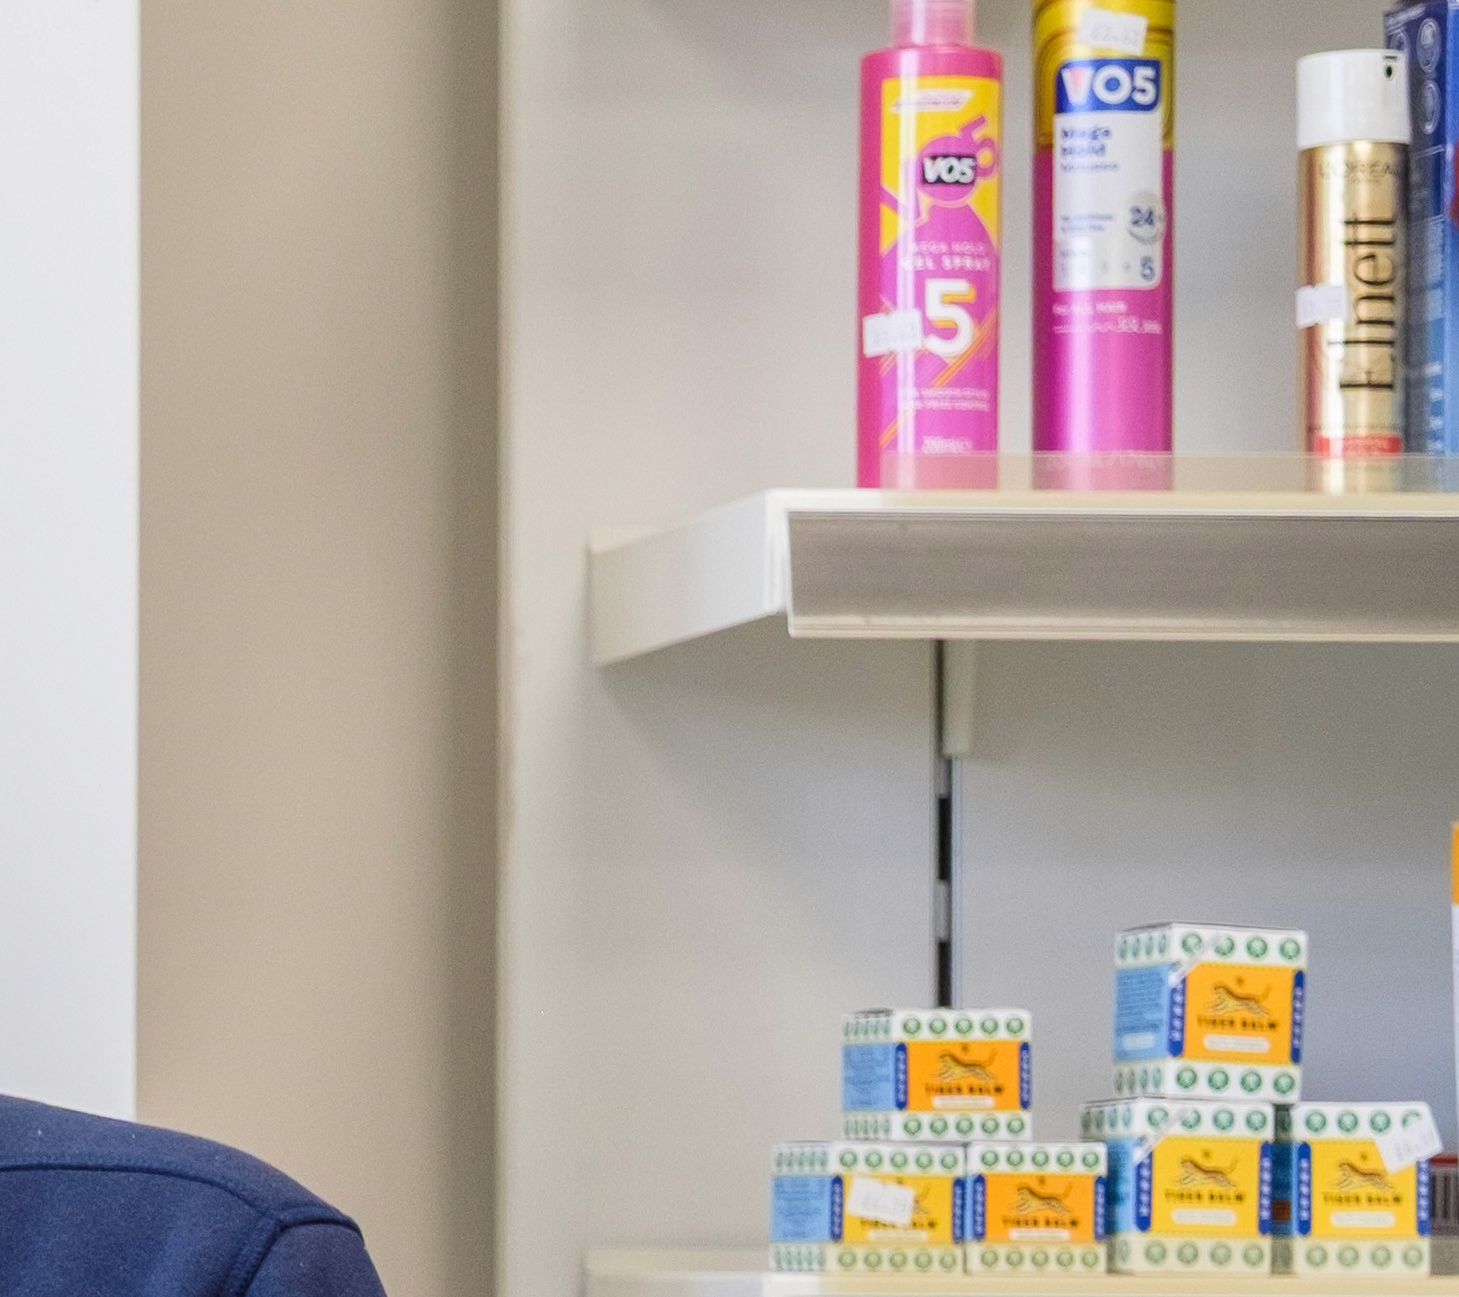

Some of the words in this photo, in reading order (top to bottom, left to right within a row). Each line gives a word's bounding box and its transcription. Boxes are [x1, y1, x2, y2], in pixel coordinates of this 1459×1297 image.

[1062, 64, 1157, 105] VO5
[923, 156, 976, 184] VO5
[924, 278, 975, 358] 5
